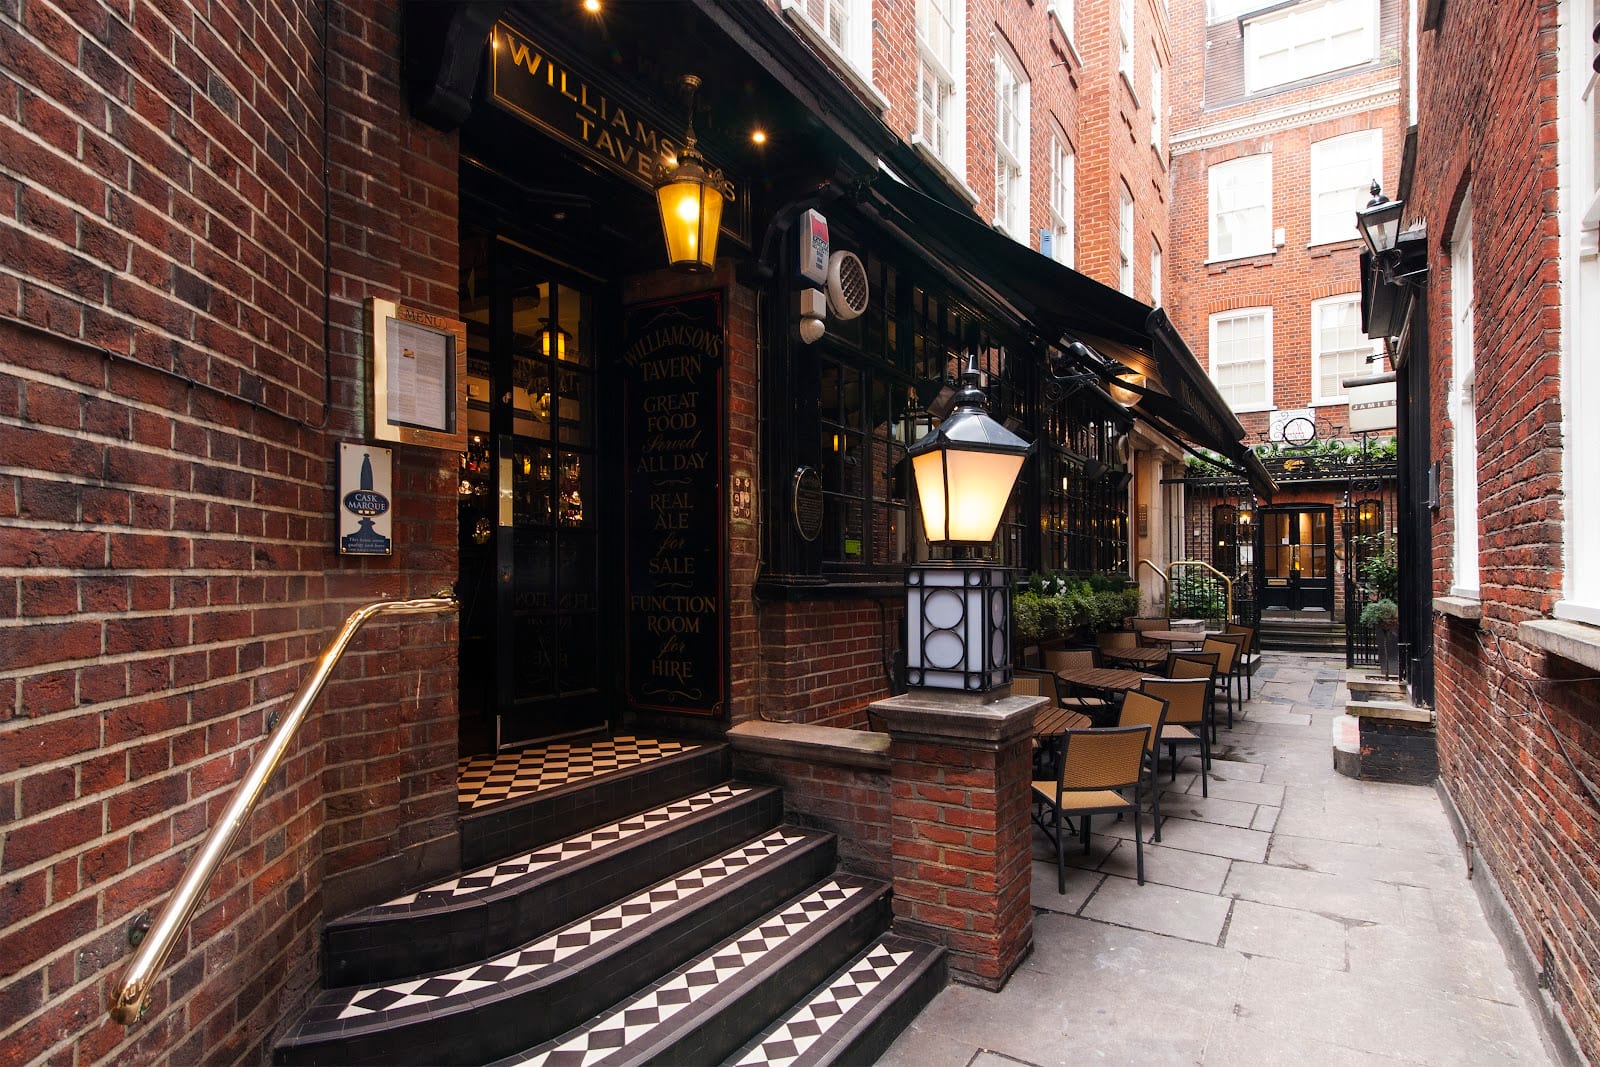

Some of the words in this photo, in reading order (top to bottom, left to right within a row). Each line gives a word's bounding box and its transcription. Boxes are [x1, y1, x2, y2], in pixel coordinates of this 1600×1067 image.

[405, 309, 443, 328] MENU
[639, 354, 702, 384] TAVERN
[643, 392, 699, 415] GREAT
[647, 412, 697, 433] FOOD
[642, 430, 702, 454] Served
[637, 456, 669, 473] ALL
[674, 451, 708, 471] DAY
[347, 501, 386, 511] MARQUE
[355, 494, 379, 502] CASK
[650, 492, 694, 516] REAL
[655, 513, 689, 530] ALE
[657, 531, 685, 556] for
[649, 557, 695, 574] SALE
[630, 595, 716, 614] FUNCTION
[647, 616, 700, 637] ROOM
[657, 635, 686, 659] for
[651, 660, 693, 685] HIRE
